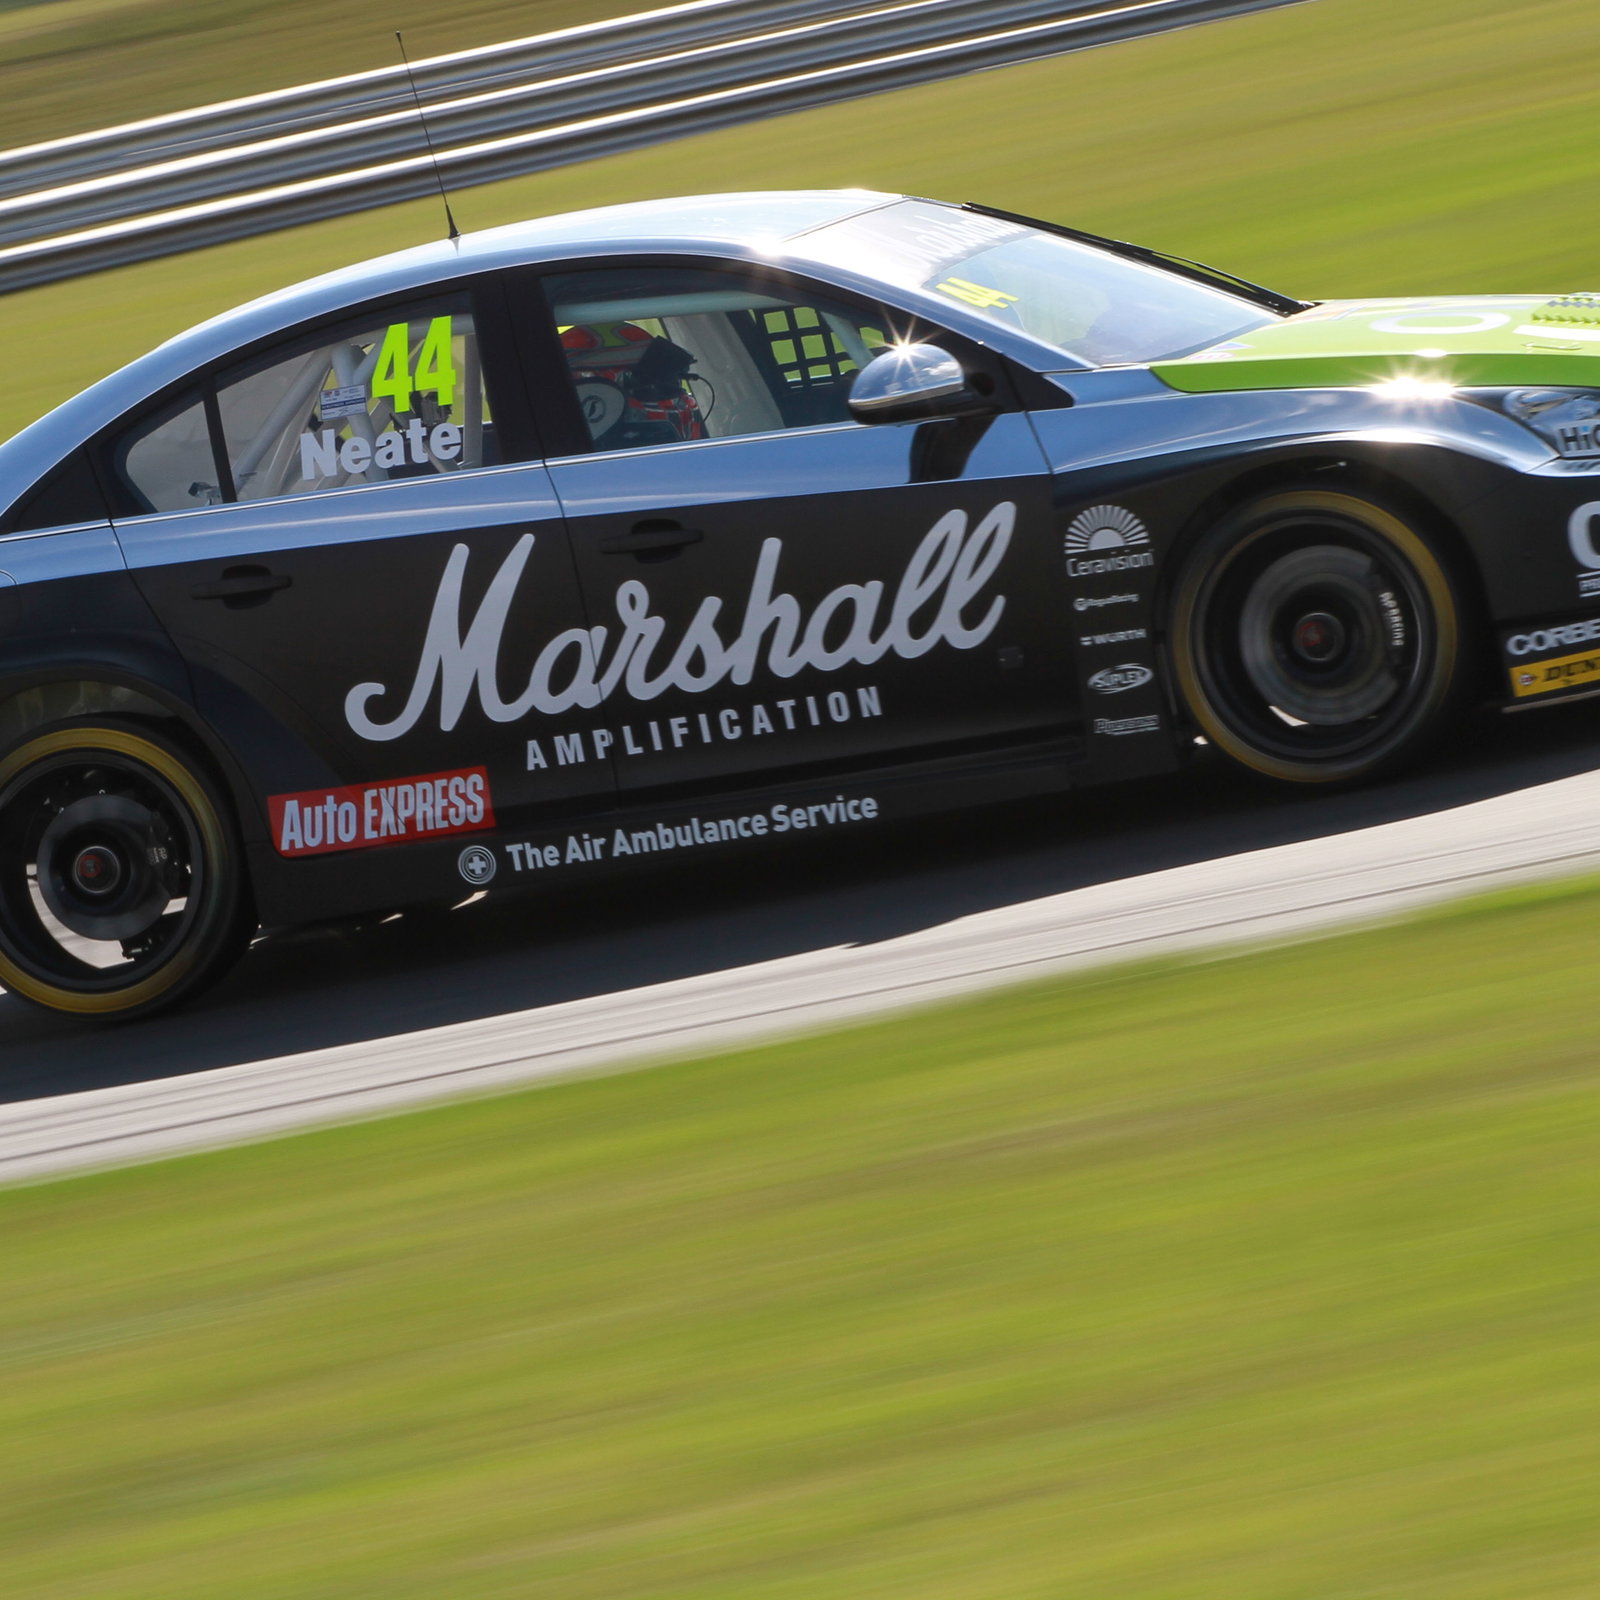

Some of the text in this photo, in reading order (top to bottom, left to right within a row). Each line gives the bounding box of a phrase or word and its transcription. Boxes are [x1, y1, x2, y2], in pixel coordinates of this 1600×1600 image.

[372, 315, 457, 414] 44
[300, 418, 463, 481] Neate
[1066, 548, 1154, 577] Ceravision
[344, 501, 1017, 742] Marshall
[526, 686, 883, 771] AMPLIFICATION
[279, 773, 484, 851] Auto EXPRESS
[506, 795, 879, 872] The Air Ambulance Service
